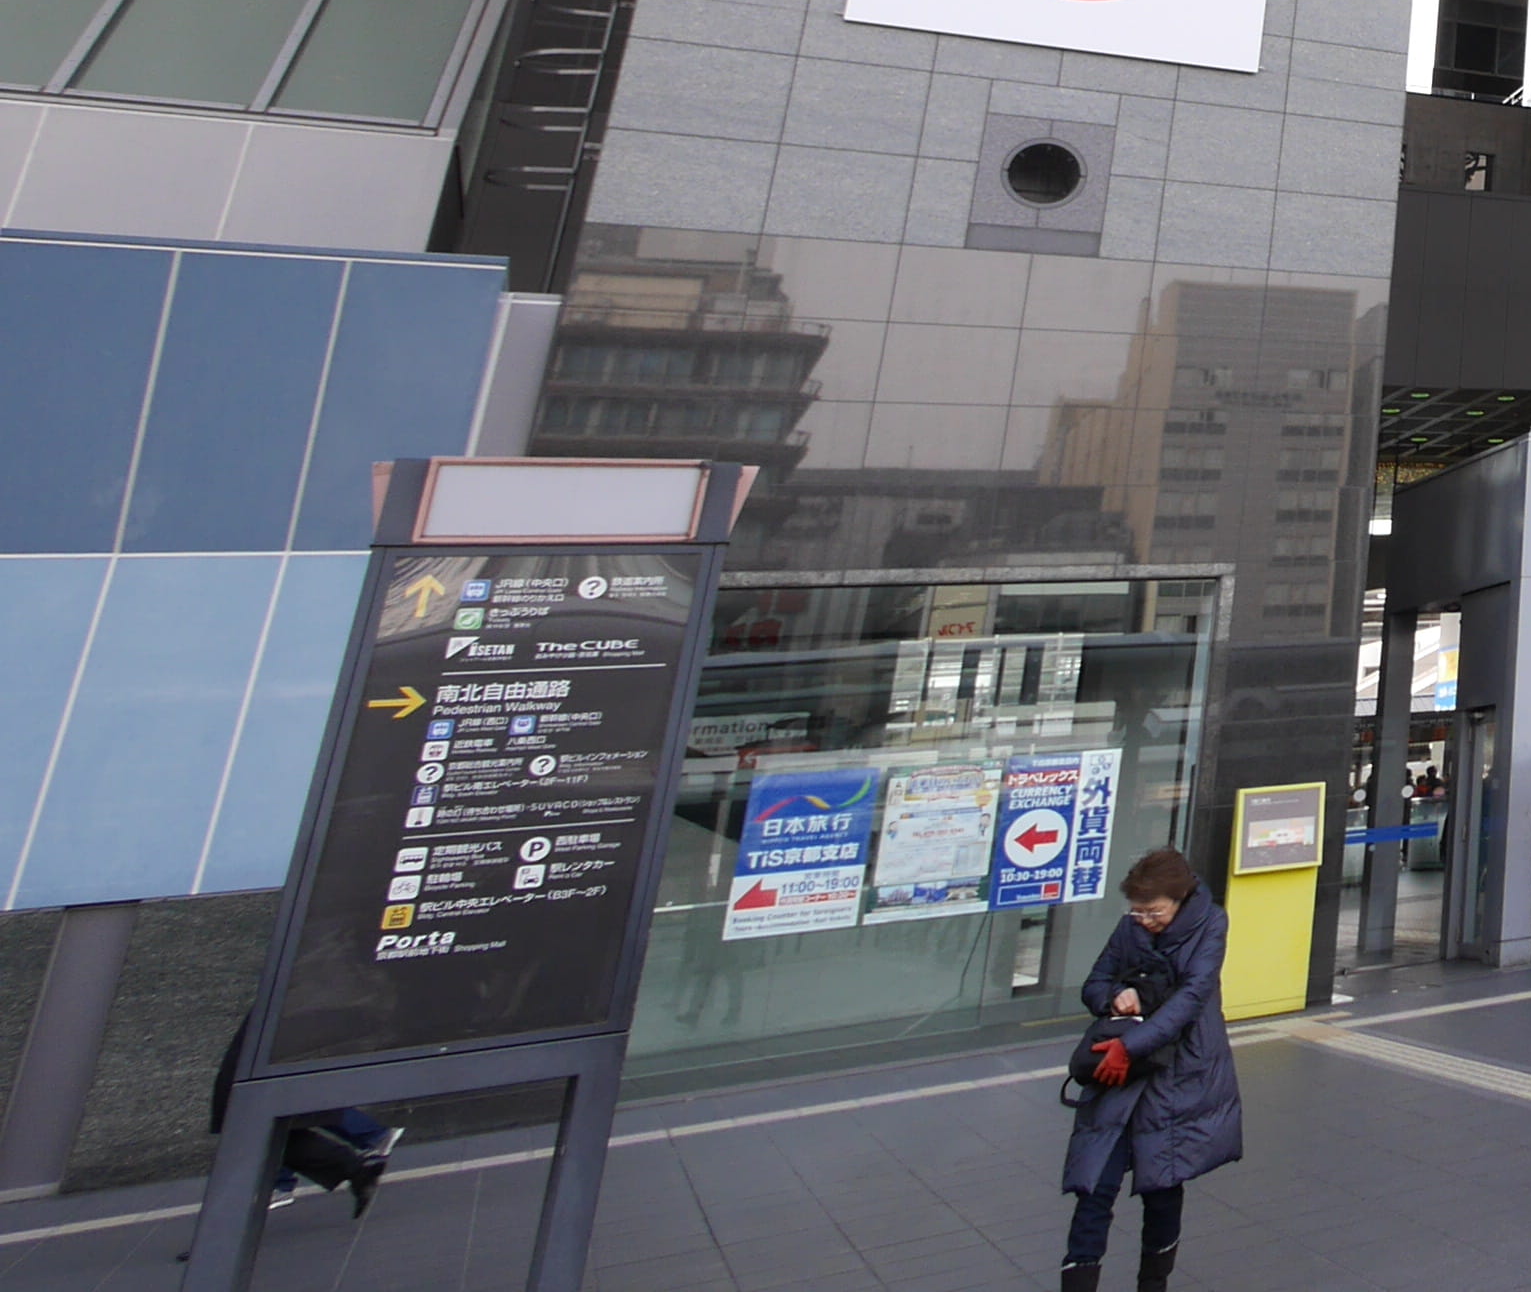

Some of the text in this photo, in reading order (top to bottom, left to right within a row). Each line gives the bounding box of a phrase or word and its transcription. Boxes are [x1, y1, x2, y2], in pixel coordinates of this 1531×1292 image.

[536, 638, 640, 652] The CUBE
[436, 679, 571, 703] 南北自由通路
[433, 701, 562, 716] Pedestrian Walkway
[693, 720, 768, 735] rmation
[1007, 770, 1080, 787] トラベレックス
[1010, 785, 1073, 800] CURRENCY
[1008, 795, 1073, 810] EXCHANGE
[762, 812, 853, 838] 日本旅行
[1072, 776, 1112, 897] 外貨両替
[748, 842, 860, 869] TiS京都支店
[375, 930, 457, 952] Porta
